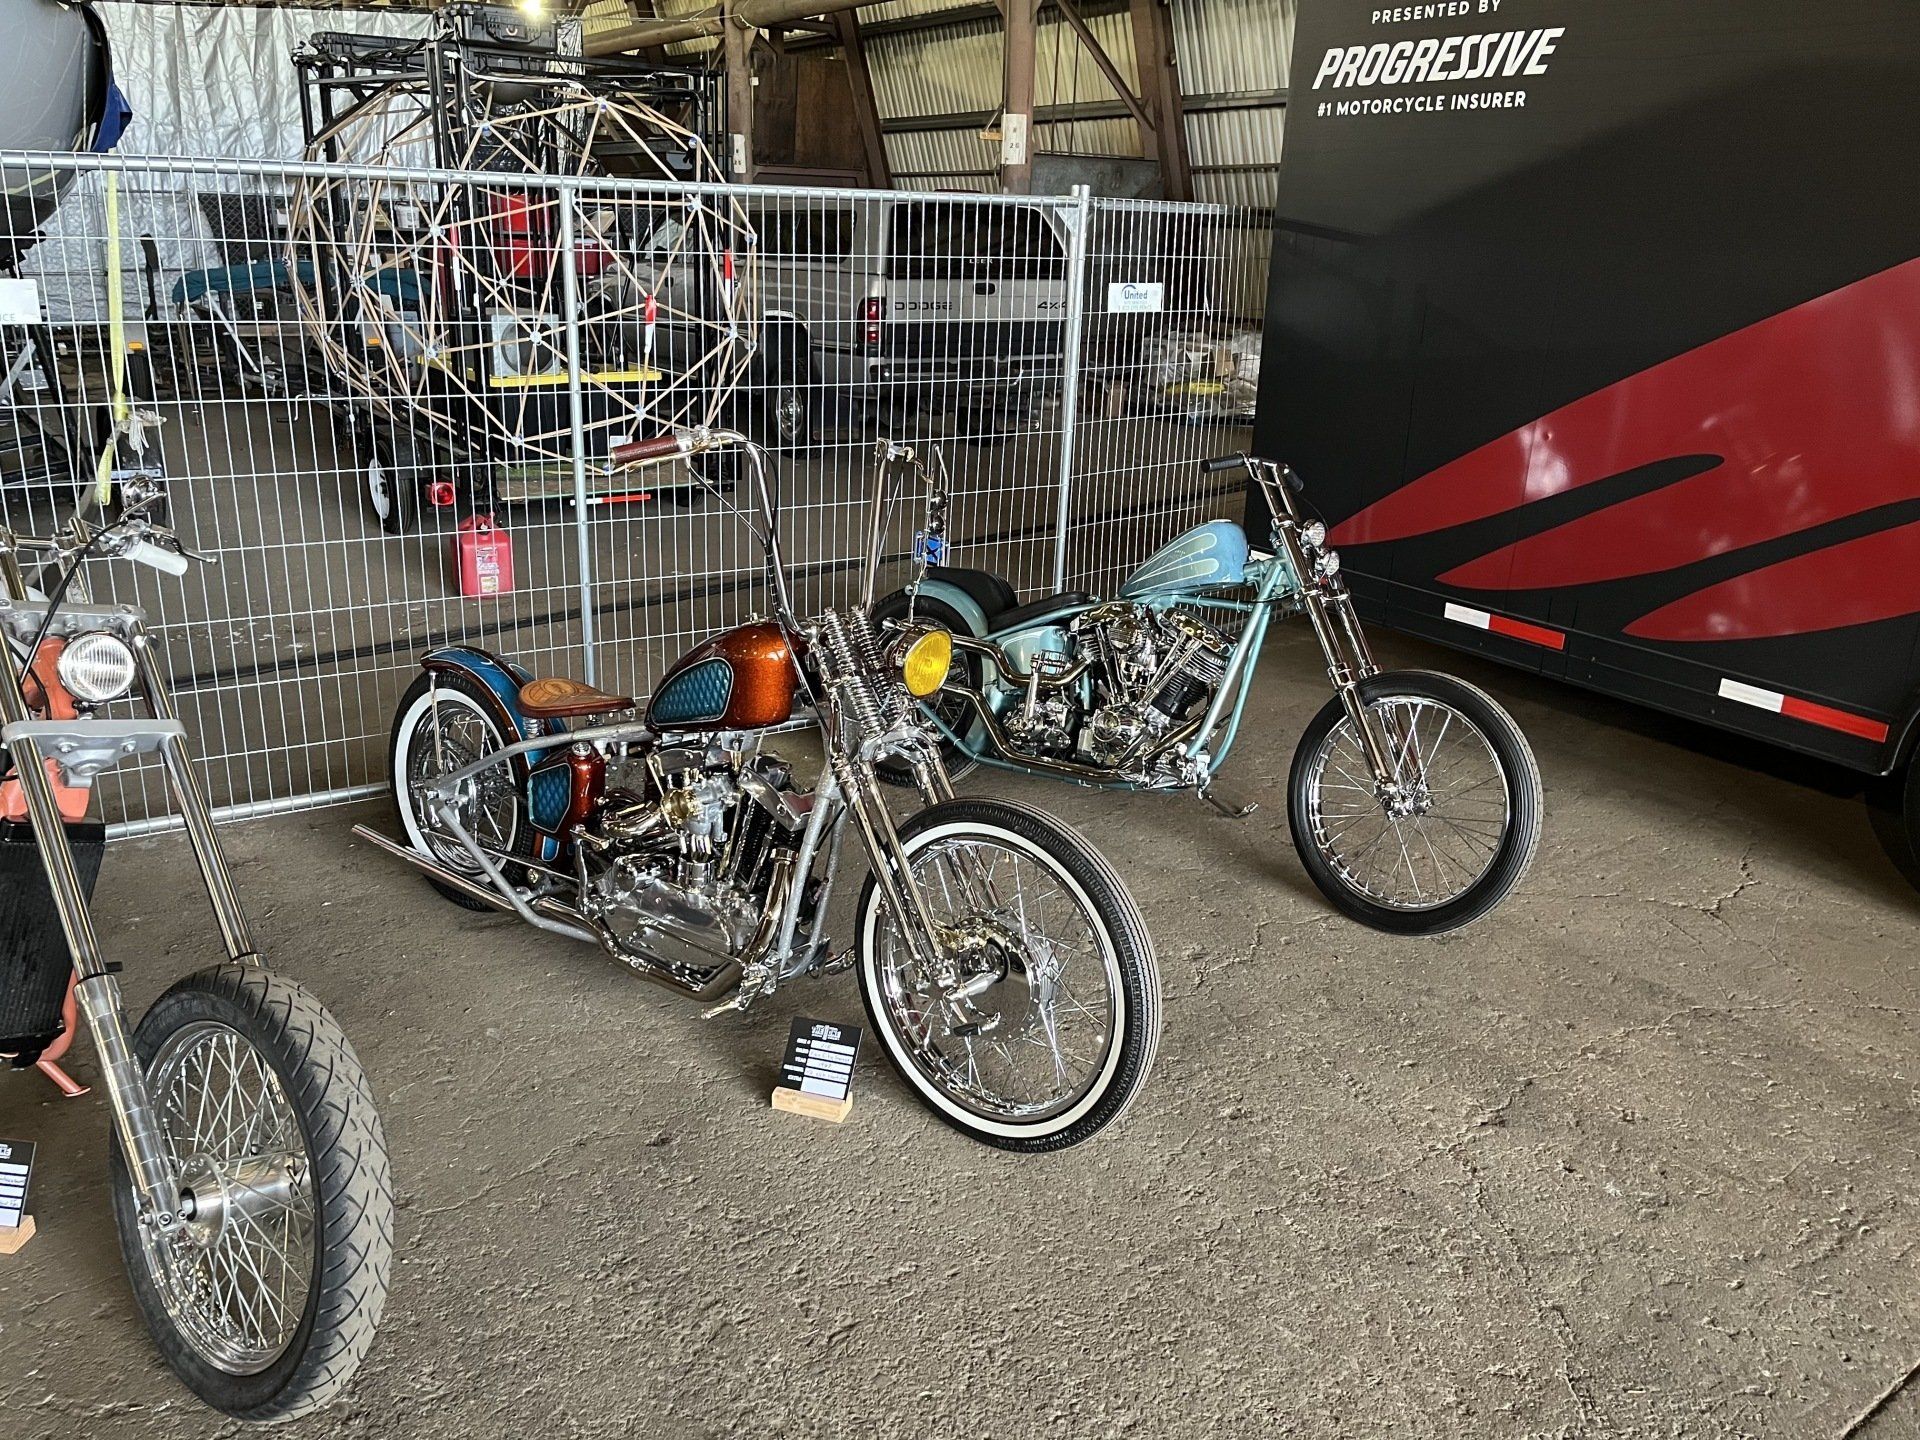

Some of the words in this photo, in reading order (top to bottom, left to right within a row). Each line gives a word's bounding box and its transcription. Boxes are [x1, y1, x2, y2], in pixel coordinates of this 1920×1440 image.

[1371, 1, 1470, 24] PRESENTED
[1478, 0, 1500, 13] BY
[1311, 27, 1566, 89] PROGRESSIVE
[1317, 102, 1332, 117] #1
[1336, 95, 1445, 116] MOTORCYCLE
[1450, 90, 1527, 110] INSURER
[894, 301, 953, 310] DODGE
[1124, 289, 1148, 300] United
